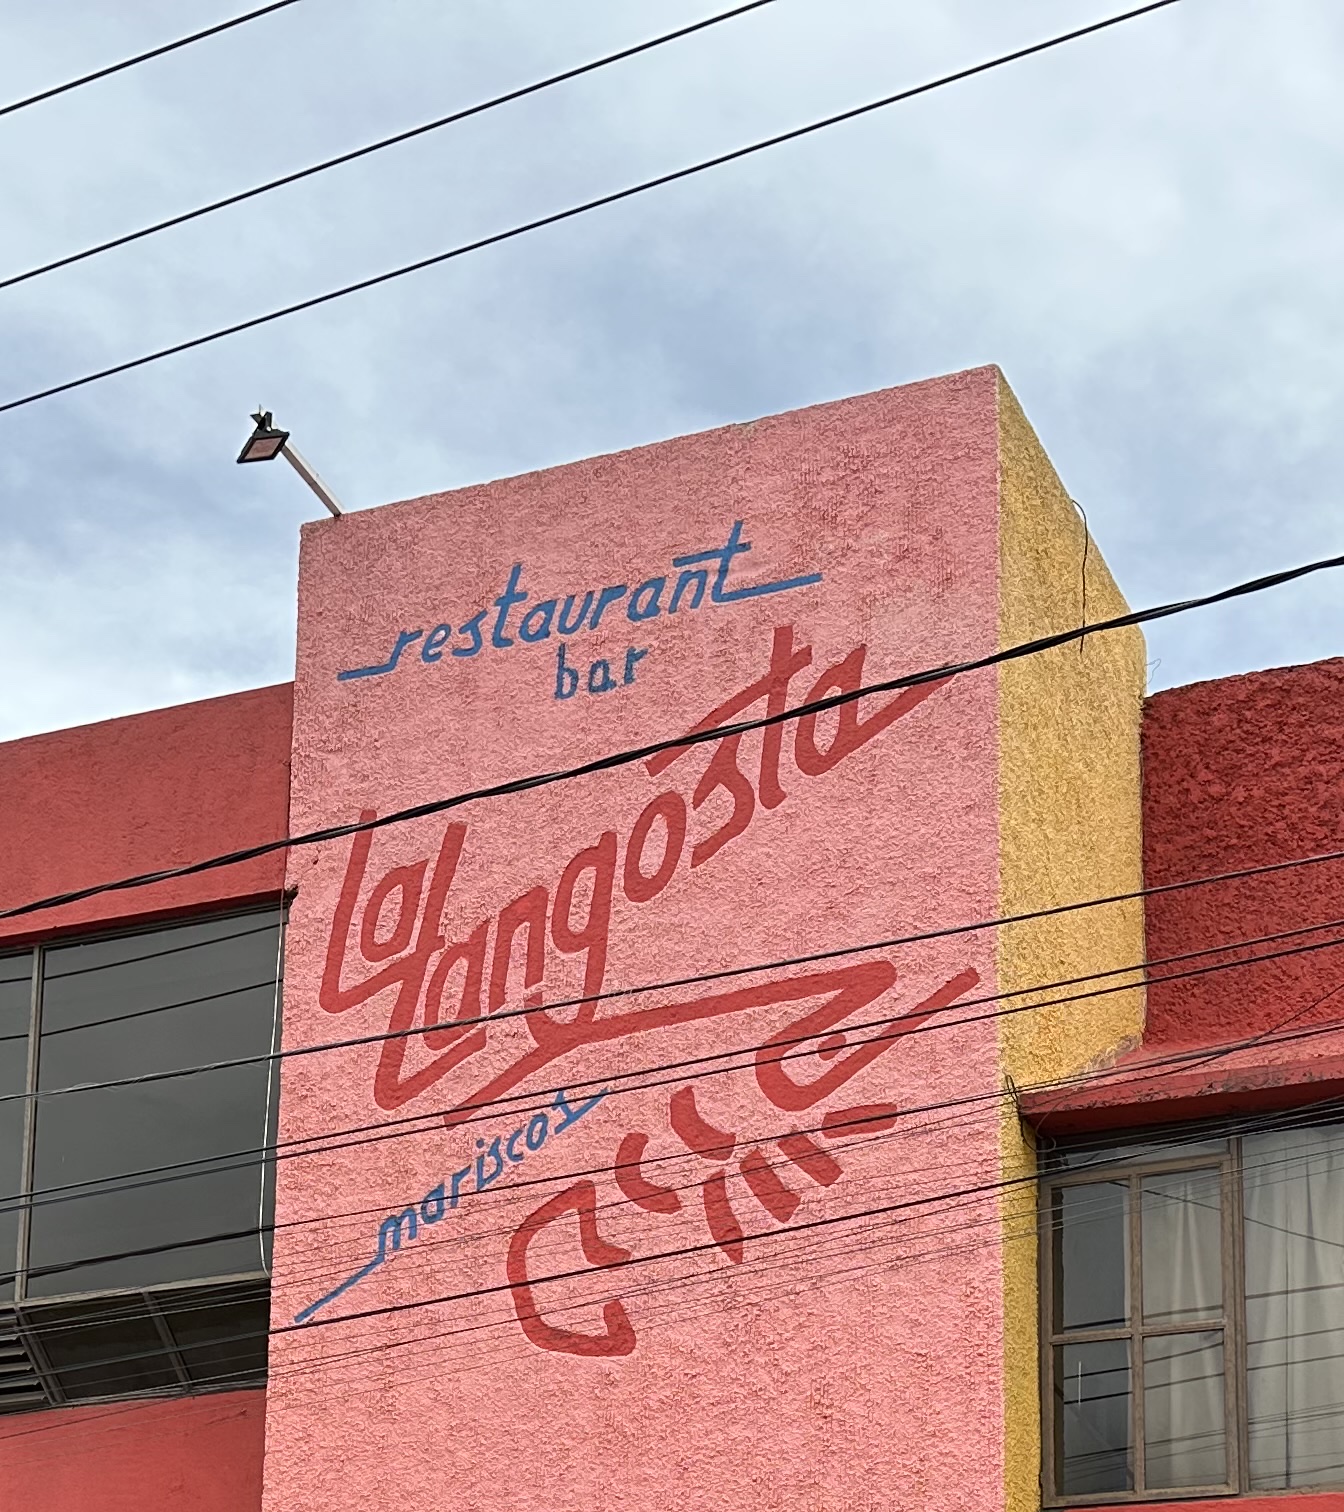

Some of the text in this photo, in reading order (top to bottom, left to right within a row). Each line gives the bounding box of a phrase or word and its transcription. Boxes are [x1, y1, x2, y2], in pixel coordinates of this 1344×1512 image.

[338, 520, 823, 681] restaurant
[554, 645, 649, 700] bar
[320, 809, 446, 1014] La
[374, 625, 959, 1112] Langosta
[294, 1087, 611, 1323] mariscos
